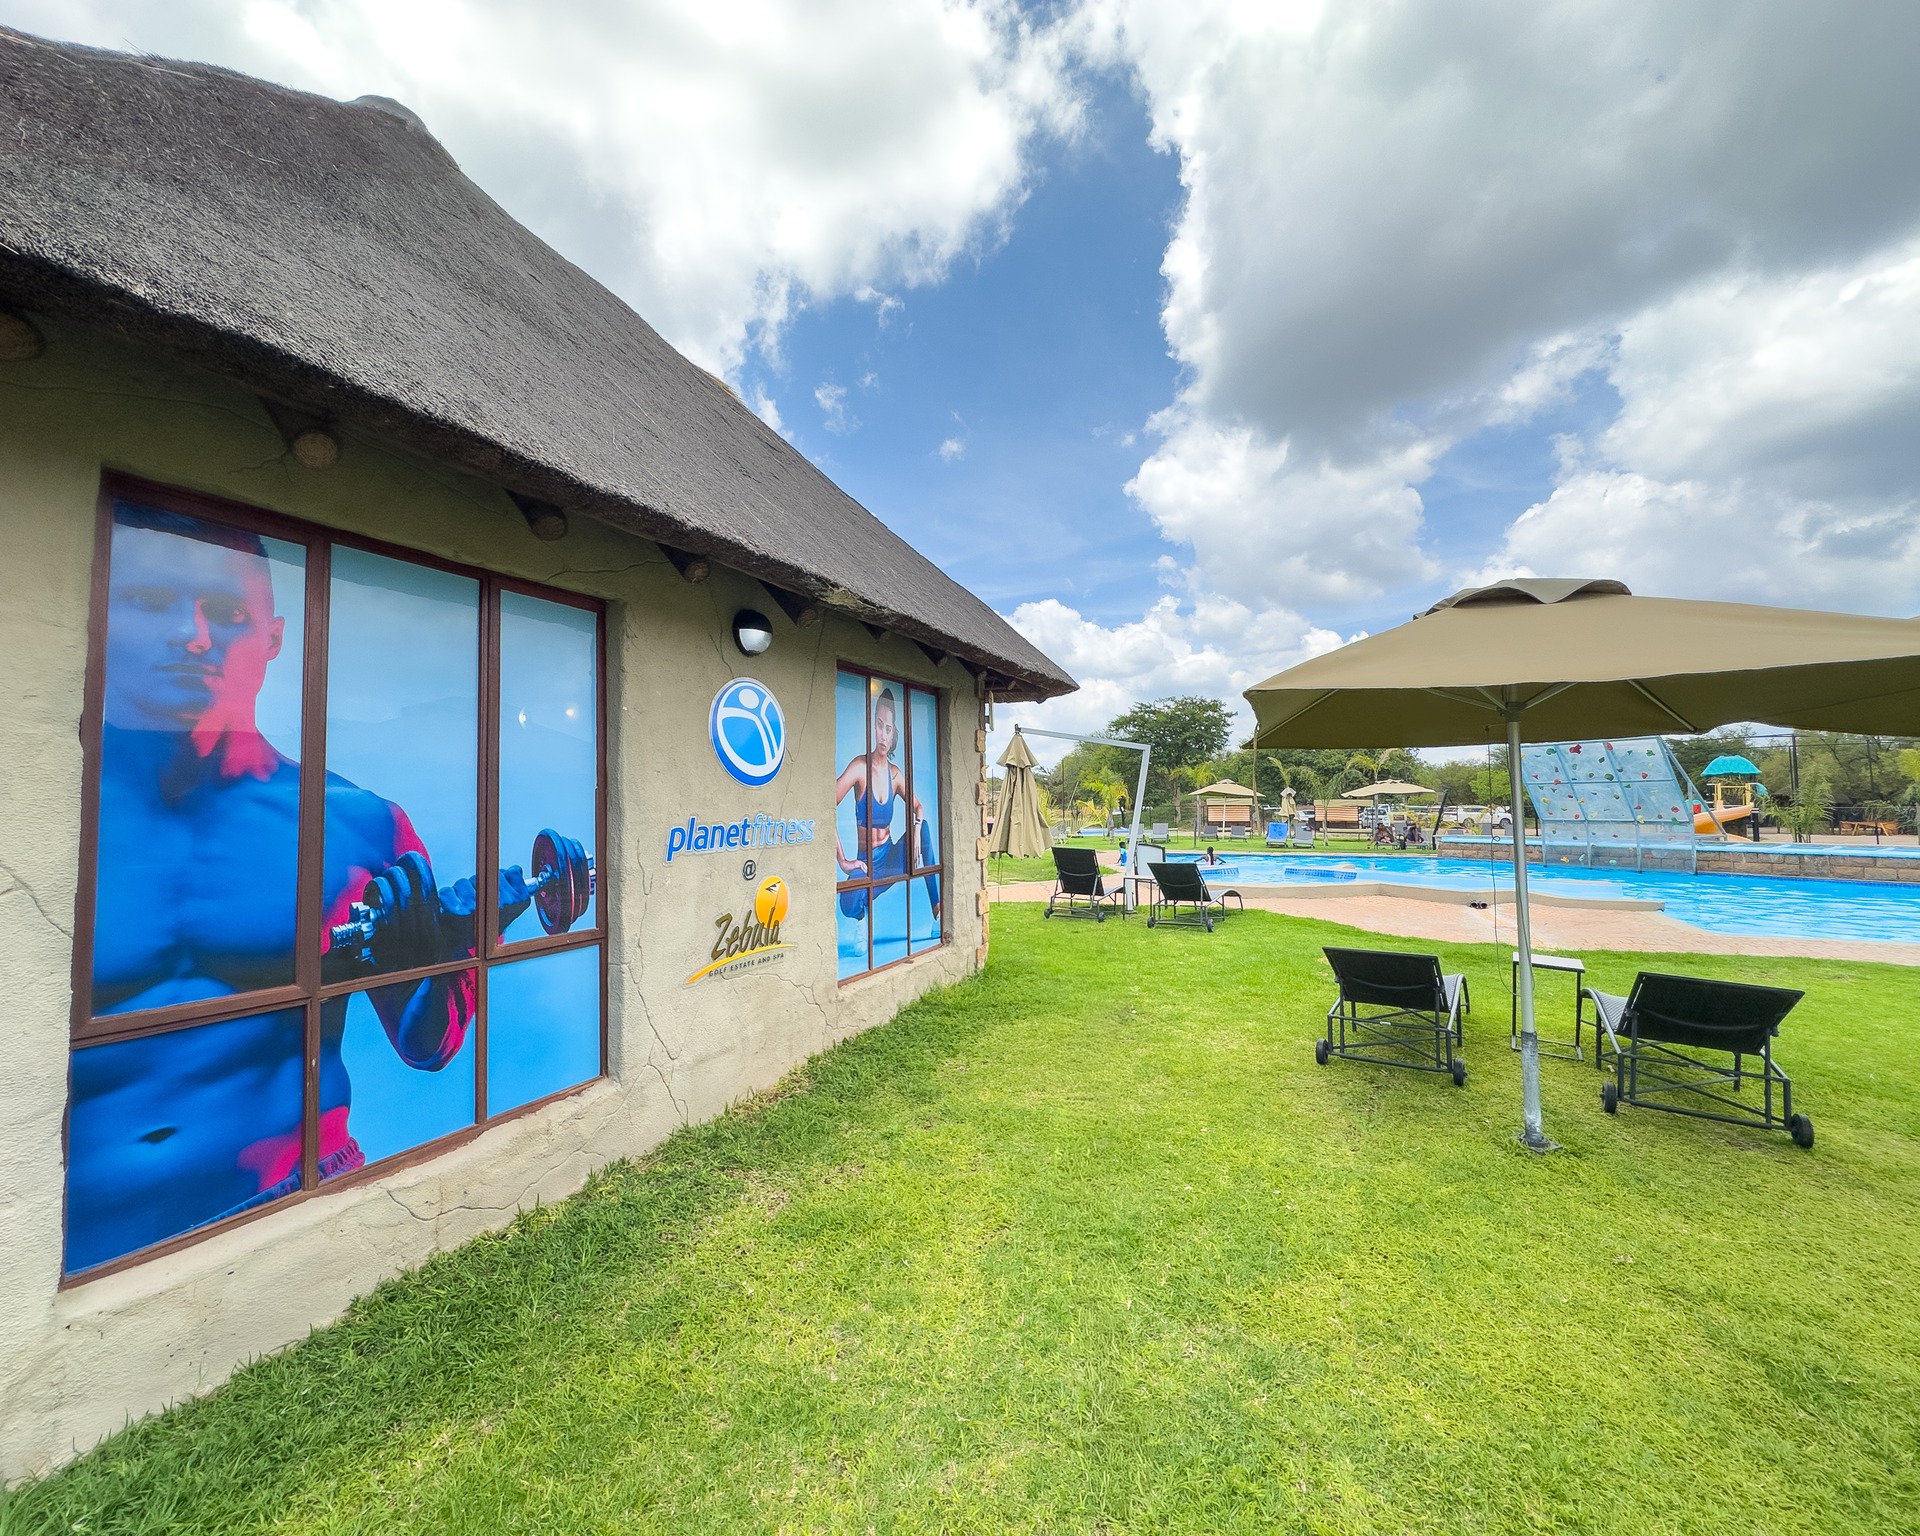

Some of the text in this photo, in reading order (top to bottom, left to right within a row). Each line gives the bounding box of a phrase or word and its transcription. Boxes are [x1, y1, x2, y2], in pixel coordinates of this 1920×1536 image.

[743, 859, 757, 881] @
[711, 907, 782, 960] Zebula
[708, 952, 785, 977] GOLF ESTATE AND SPA
